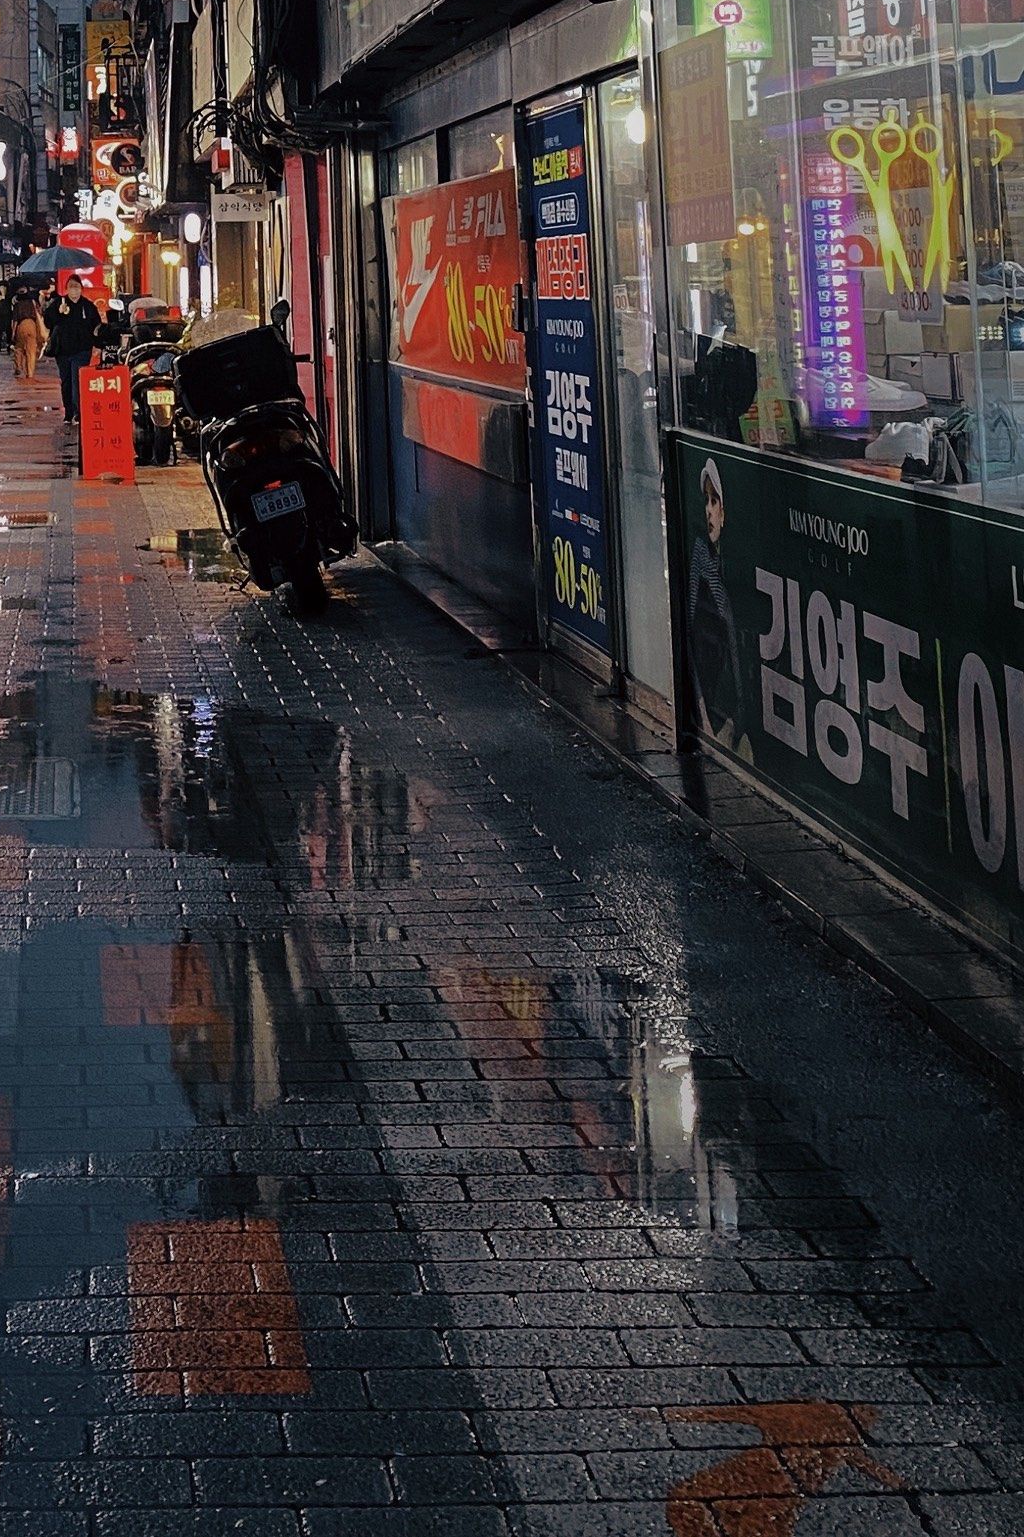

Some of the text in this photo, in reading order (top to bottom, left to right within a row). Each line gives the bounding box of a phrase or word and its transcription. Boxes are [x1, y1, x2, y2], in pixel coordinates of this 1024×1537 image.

[88, 375, 122, 394] 돼지
[545, 369, 593, 444] 김영주
[754, 566, 929, 822] 김영주
